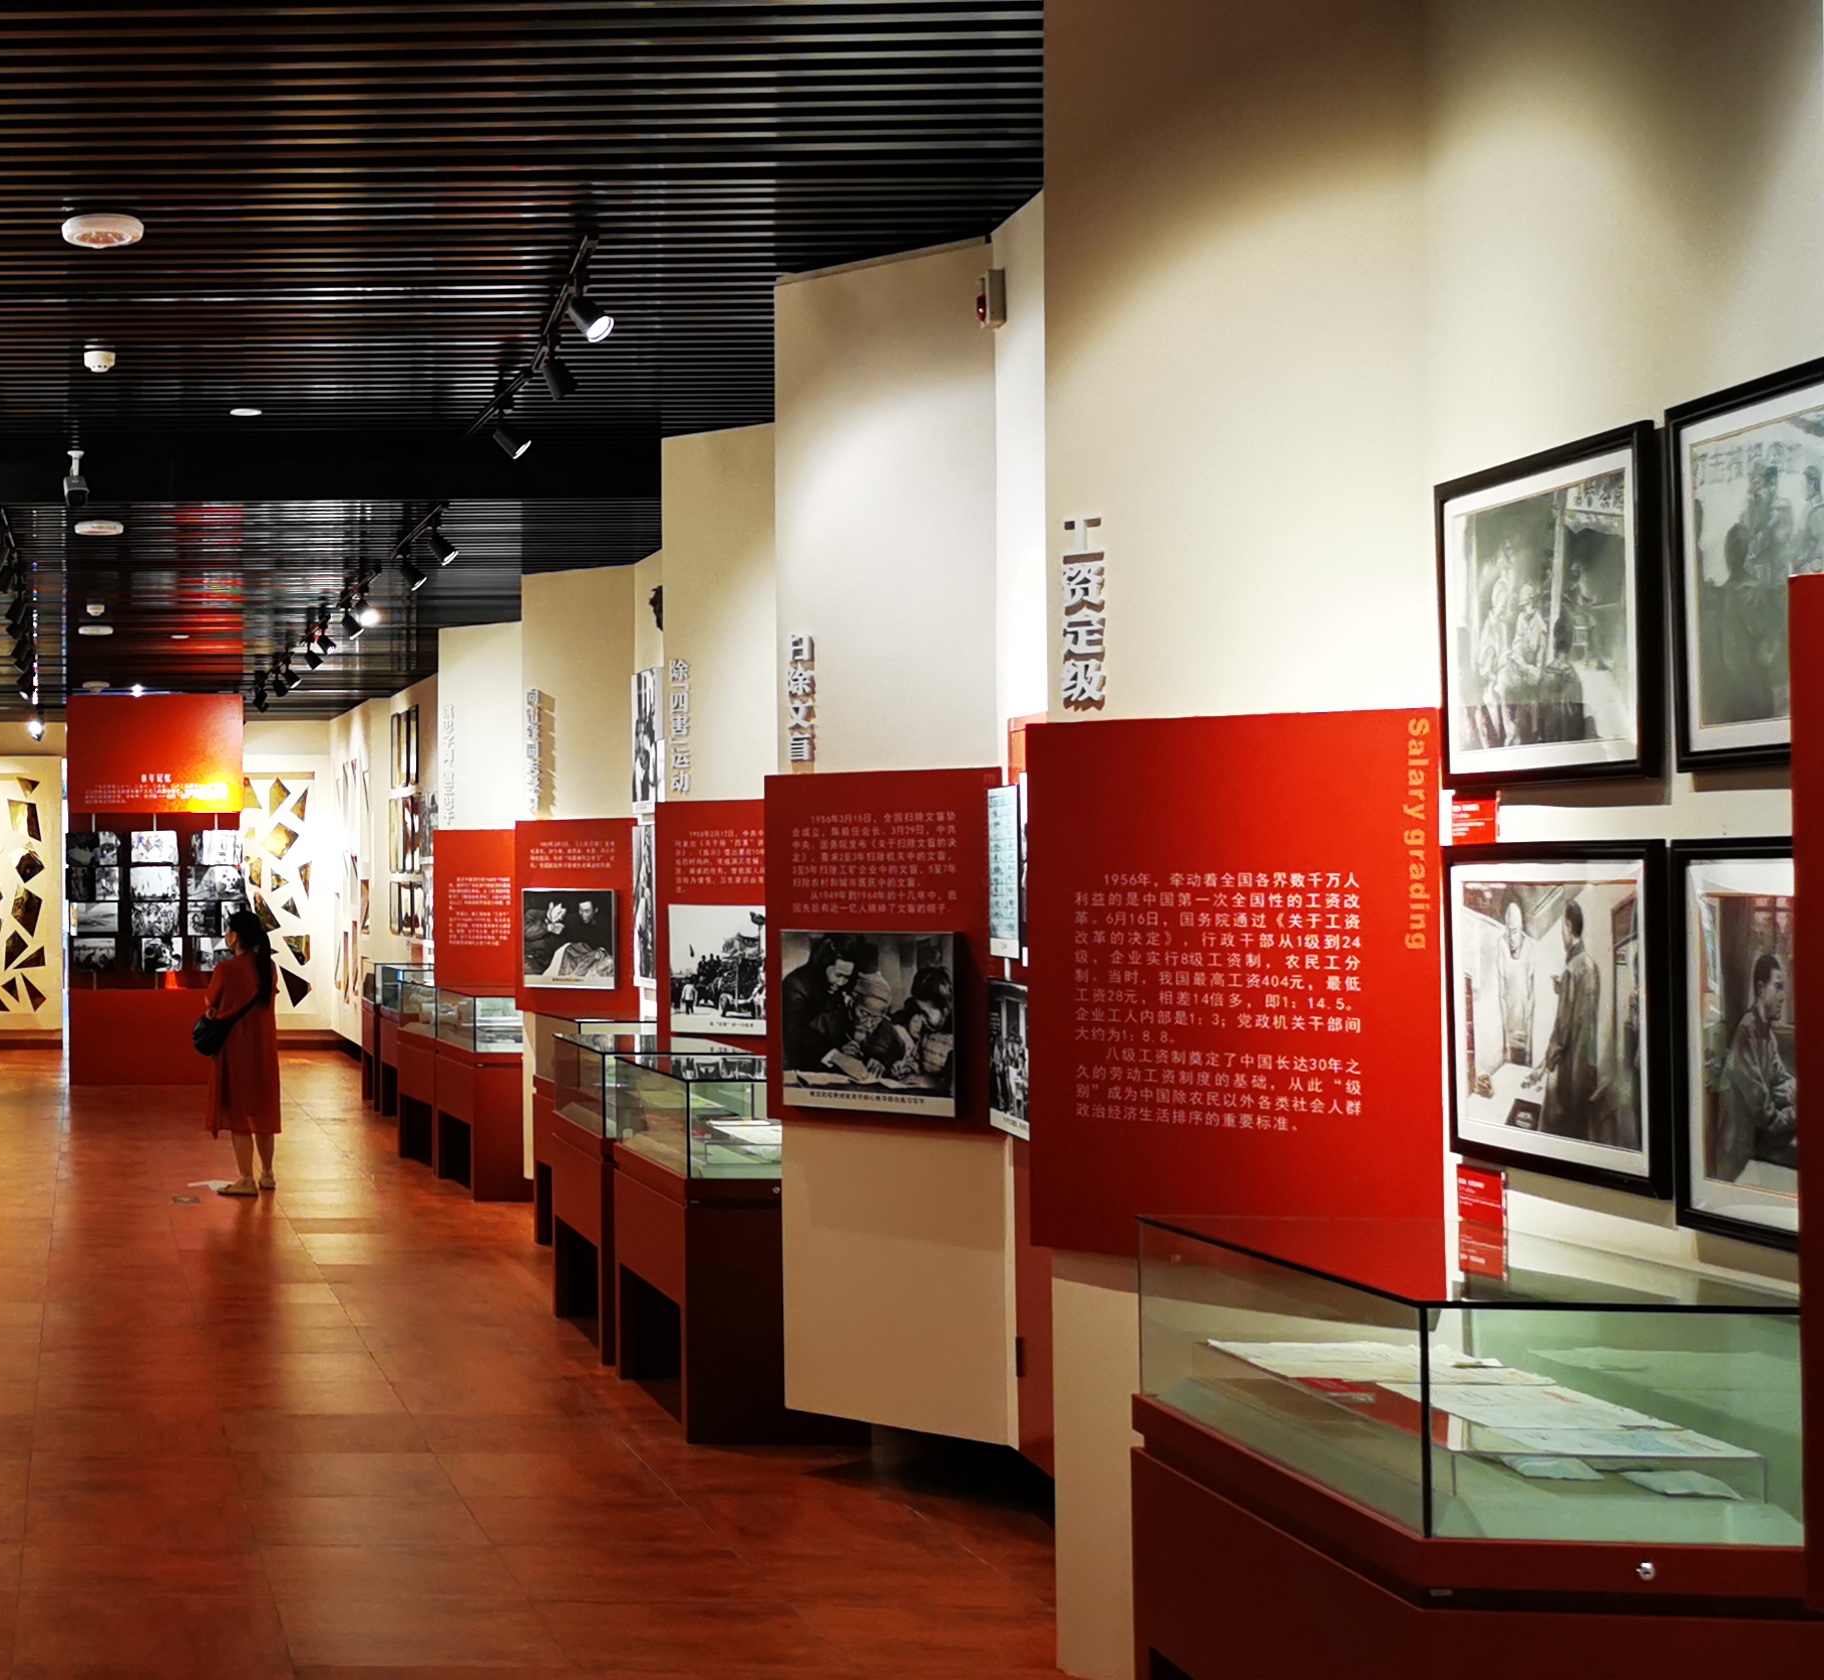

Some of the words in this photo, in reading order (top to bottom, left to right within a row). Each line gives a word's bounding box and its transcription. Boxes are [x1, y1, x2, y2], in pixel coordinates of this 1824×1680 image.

[1061, 515, 1105, 706] 工资定级
[1403, 718, 1430, 820] Salary
[1075, 891, 1360, 909] 利益的是中国第一次全国性的工资改
[1404, 829, 1431, 949] grading
[1105, 1047, 1361, 1075] 八级工资制奠定了中国长达30年之
